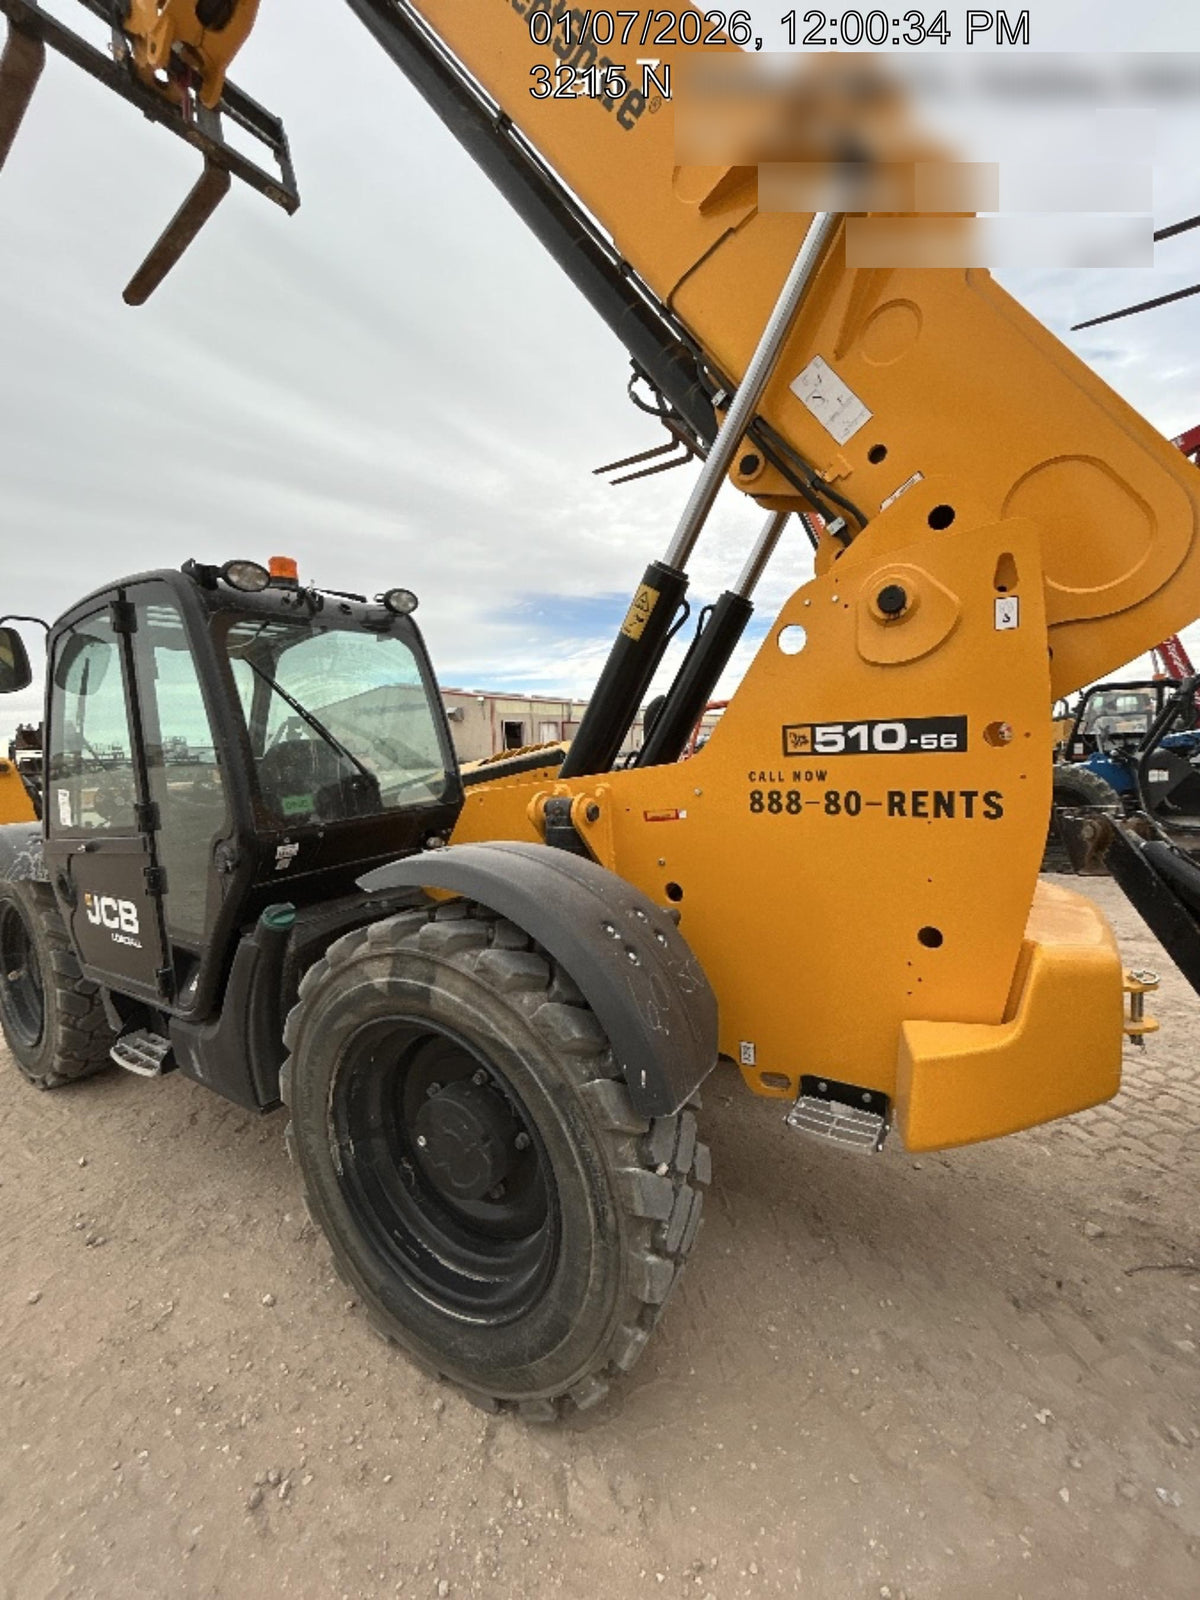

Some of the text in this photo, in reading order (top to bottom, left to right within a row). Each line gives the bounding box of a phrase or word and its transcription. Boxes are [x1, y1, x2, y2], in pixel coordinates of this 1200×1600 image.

[813, 722, 958, 753] 510-56
[748, 769, 828, 783] CALL NOW
[749, 789, 1005, 821] 888-80-RENTS
[86, 893, 140, 935] JCB
